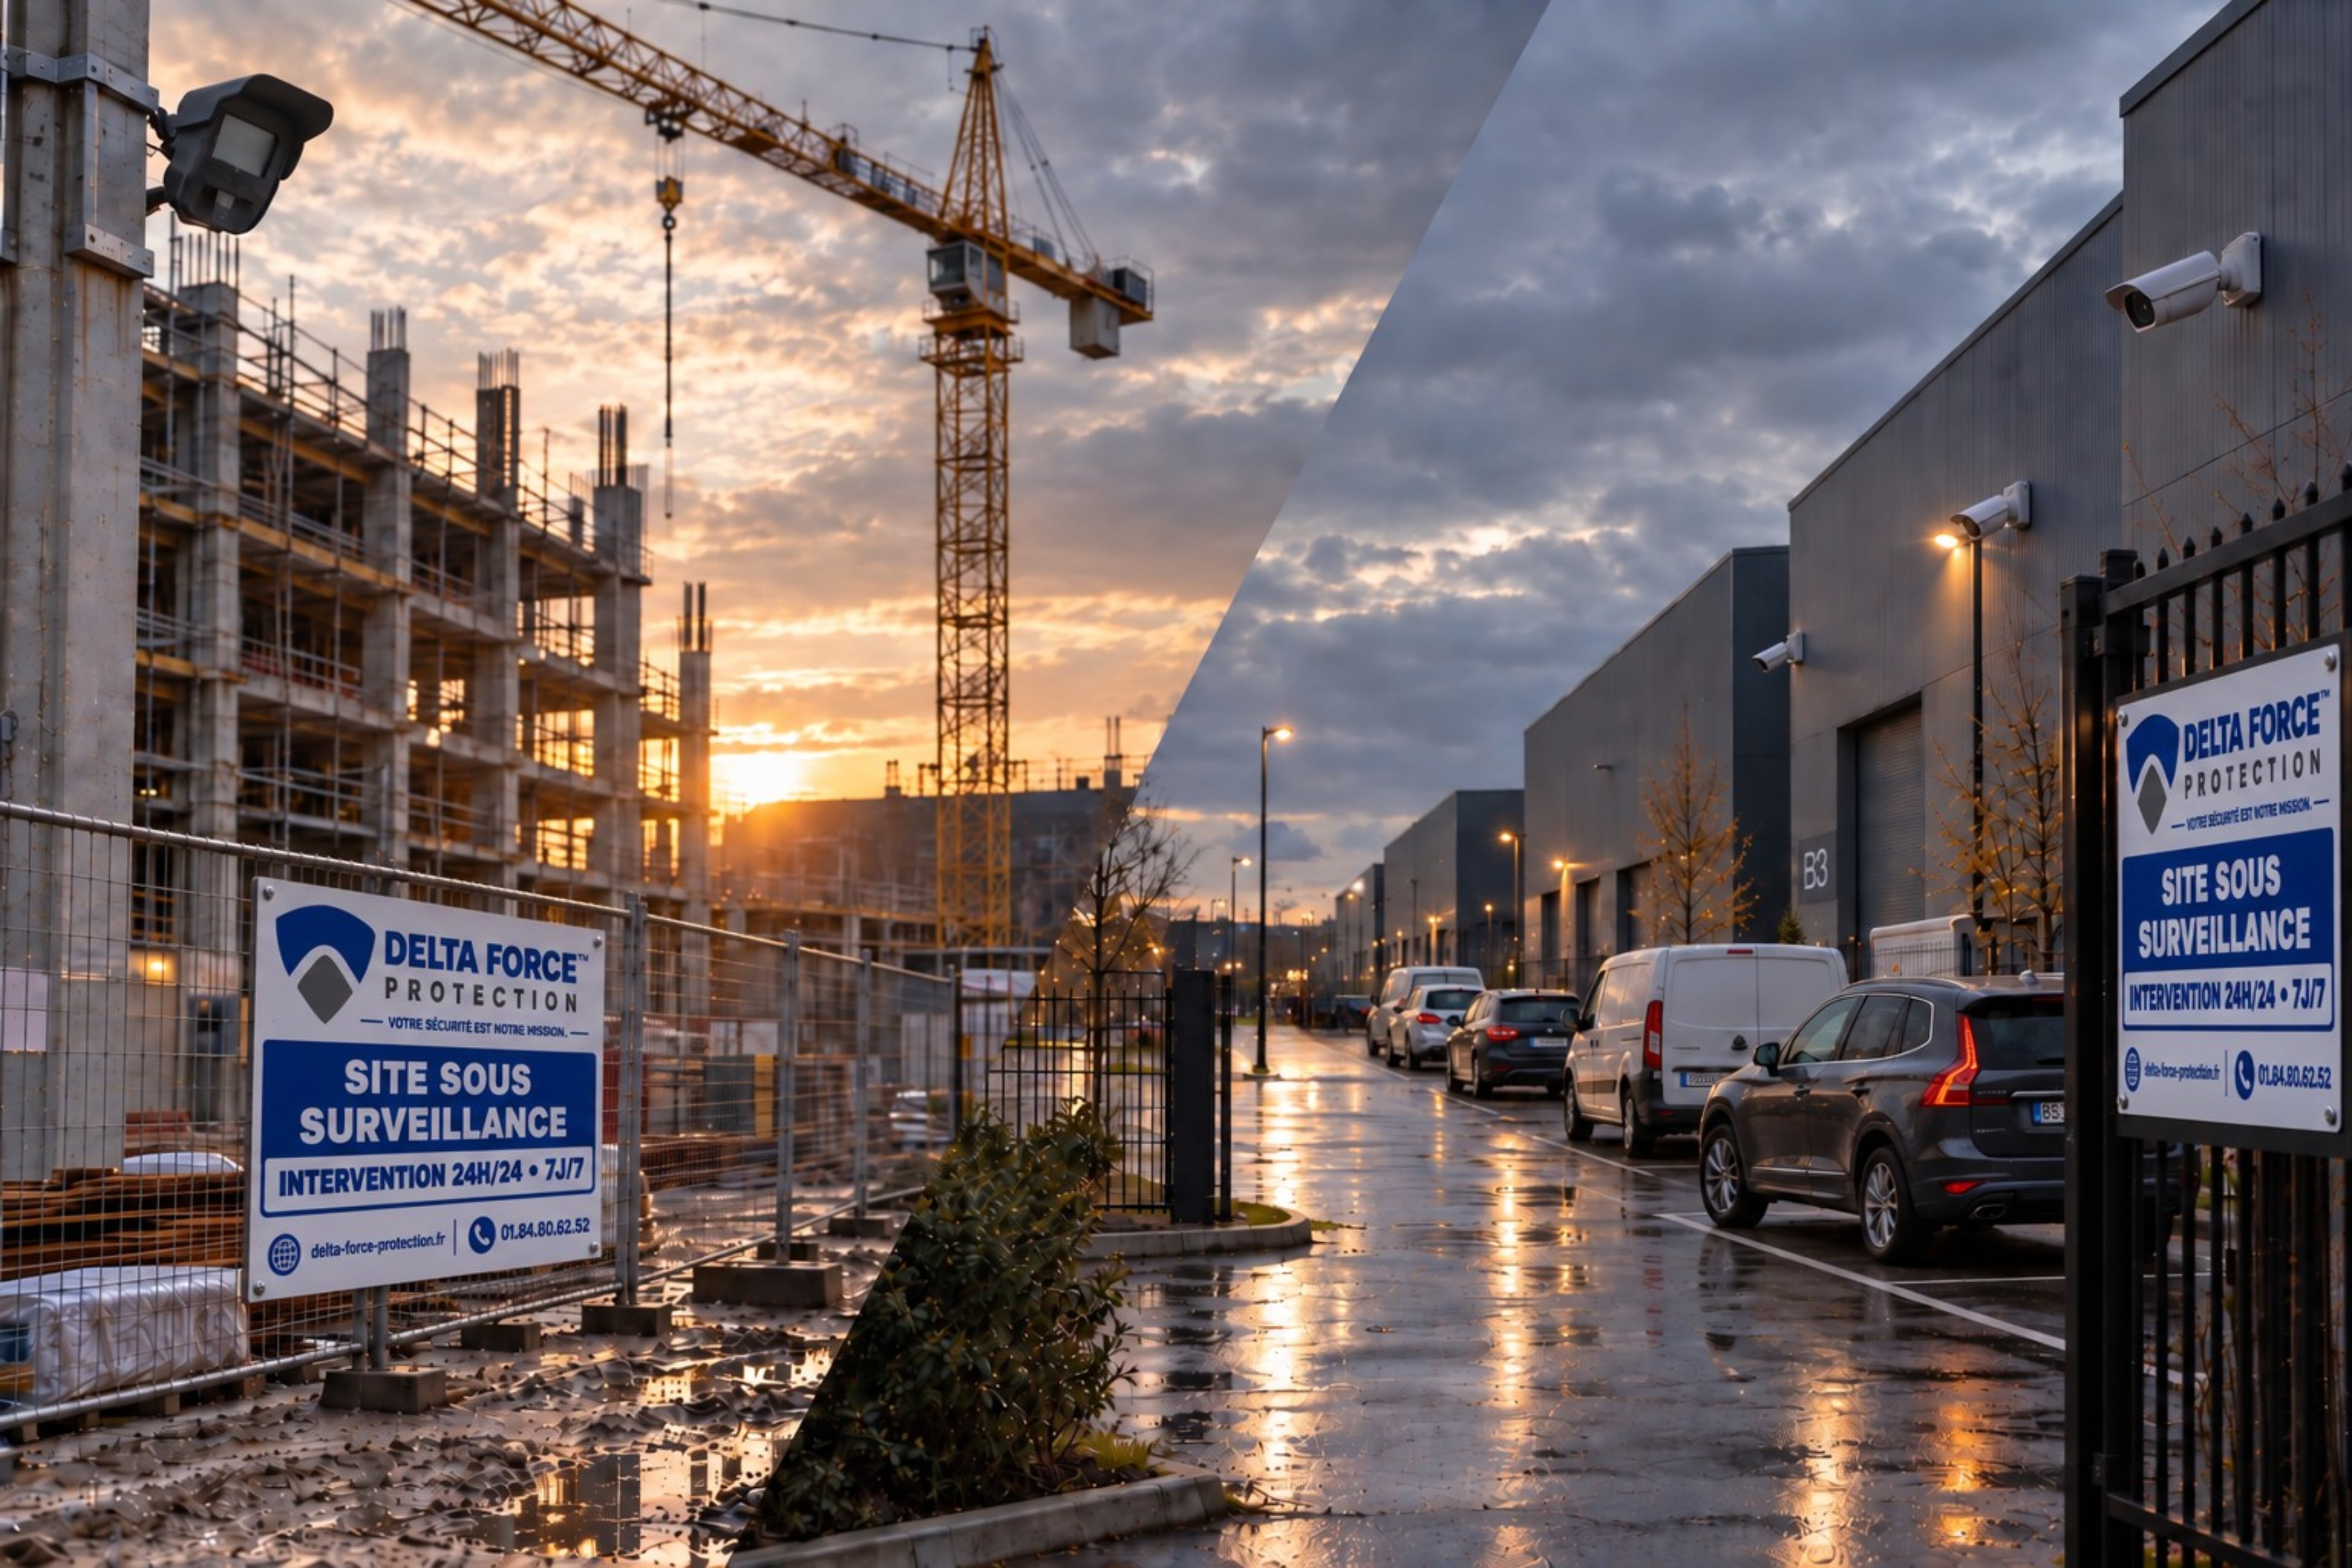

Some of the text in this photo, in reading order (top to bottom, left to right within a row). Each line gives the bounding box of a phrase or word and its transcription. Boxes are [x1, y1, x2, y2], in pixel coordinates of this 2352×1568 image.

[2184, 712, 2244, 763] DELTA
[2184, 747, 2321, 800] PROTECTION
[1804, 848, 1829, 890] B3
[2162, 854, 2281, 906] SITE SOUS
[385, 930, 479, 974] DELTA
[2139, 906, 2311, 959] SURVEILLANCE
[385, 976, 577, 1013] PROTECTION
[2130, 977, 2326, 1012] INTERVENTION 24H/24 7J/7
[389, 1016, 423, 1030] VOTRE
[425, 1016, 472, 1033] SÉCURITÉ
[474, 1022, 492, 1034] EST
[345, 1059, 532, 1096] SITE SOUS
[299, 1106, 567, 1145] SURVEILLANCE
[279, 1157, 585, 1196] INTERVENTION 24H/24 7J/7
[311, 1232, 446, 1259] delta-force-protection.fr
[501, 1217, 590, 1241] 01.84.80.62.52
